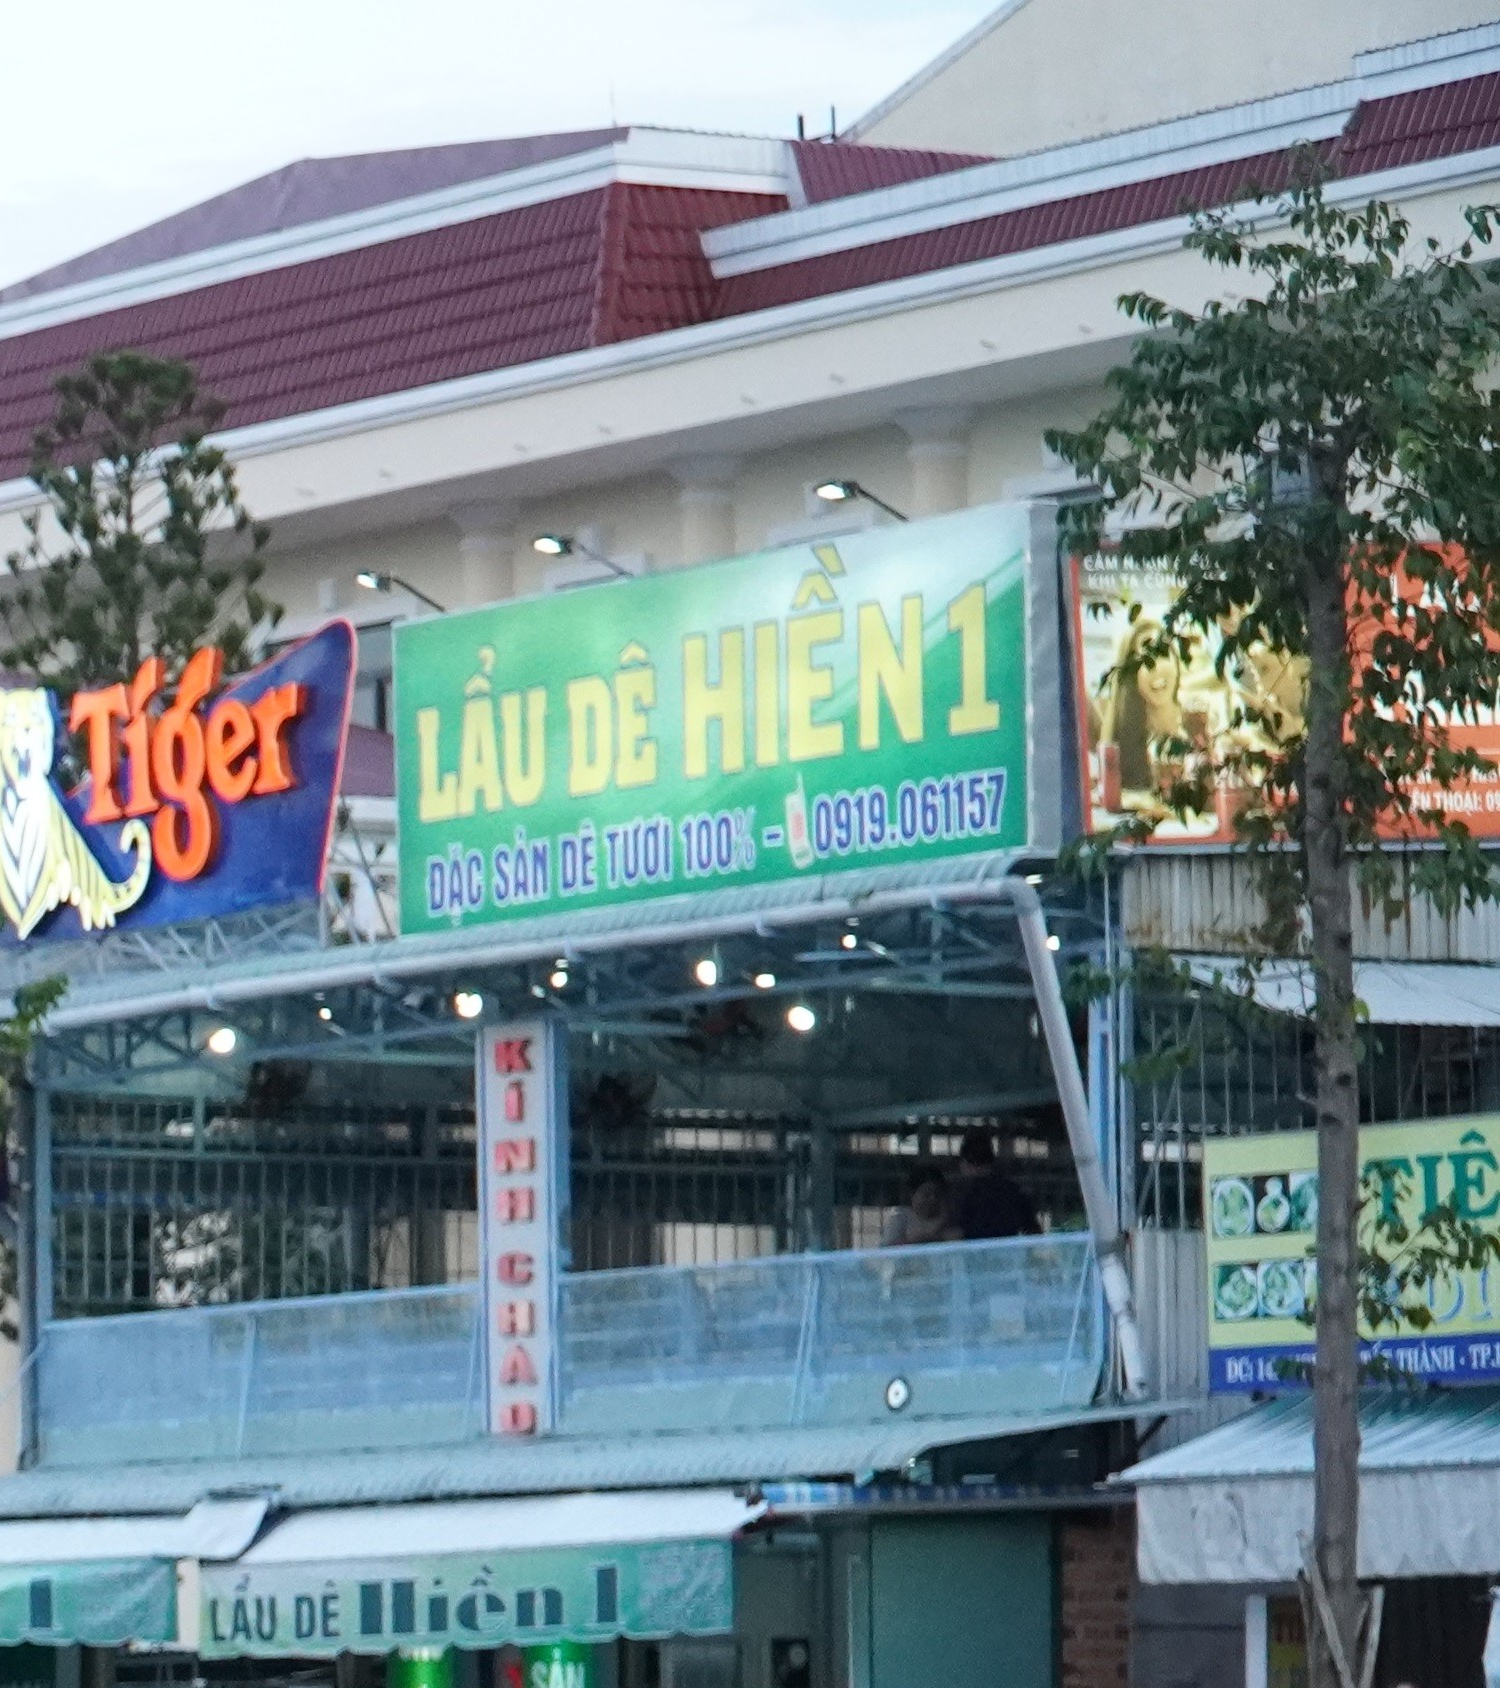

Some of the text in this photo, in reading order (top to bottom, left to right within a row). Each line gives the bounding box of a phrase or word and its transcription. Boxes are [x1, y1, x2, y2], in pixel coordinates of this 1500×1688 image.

[69, 646, 300, 881] Tiger
[417, 545, 1001, 823] LẨU DÊ HIỀN 1
[428, 843, 483, 926] ĐẶC
[495, 826, 550, 904] SẢN
[561, 822, 595, 892] DÊ
[682, 807, 756, 875] 100%
[812, 771, 1006, 857] 0919.061157
[295, 1581, 341, 1638] DÊ
